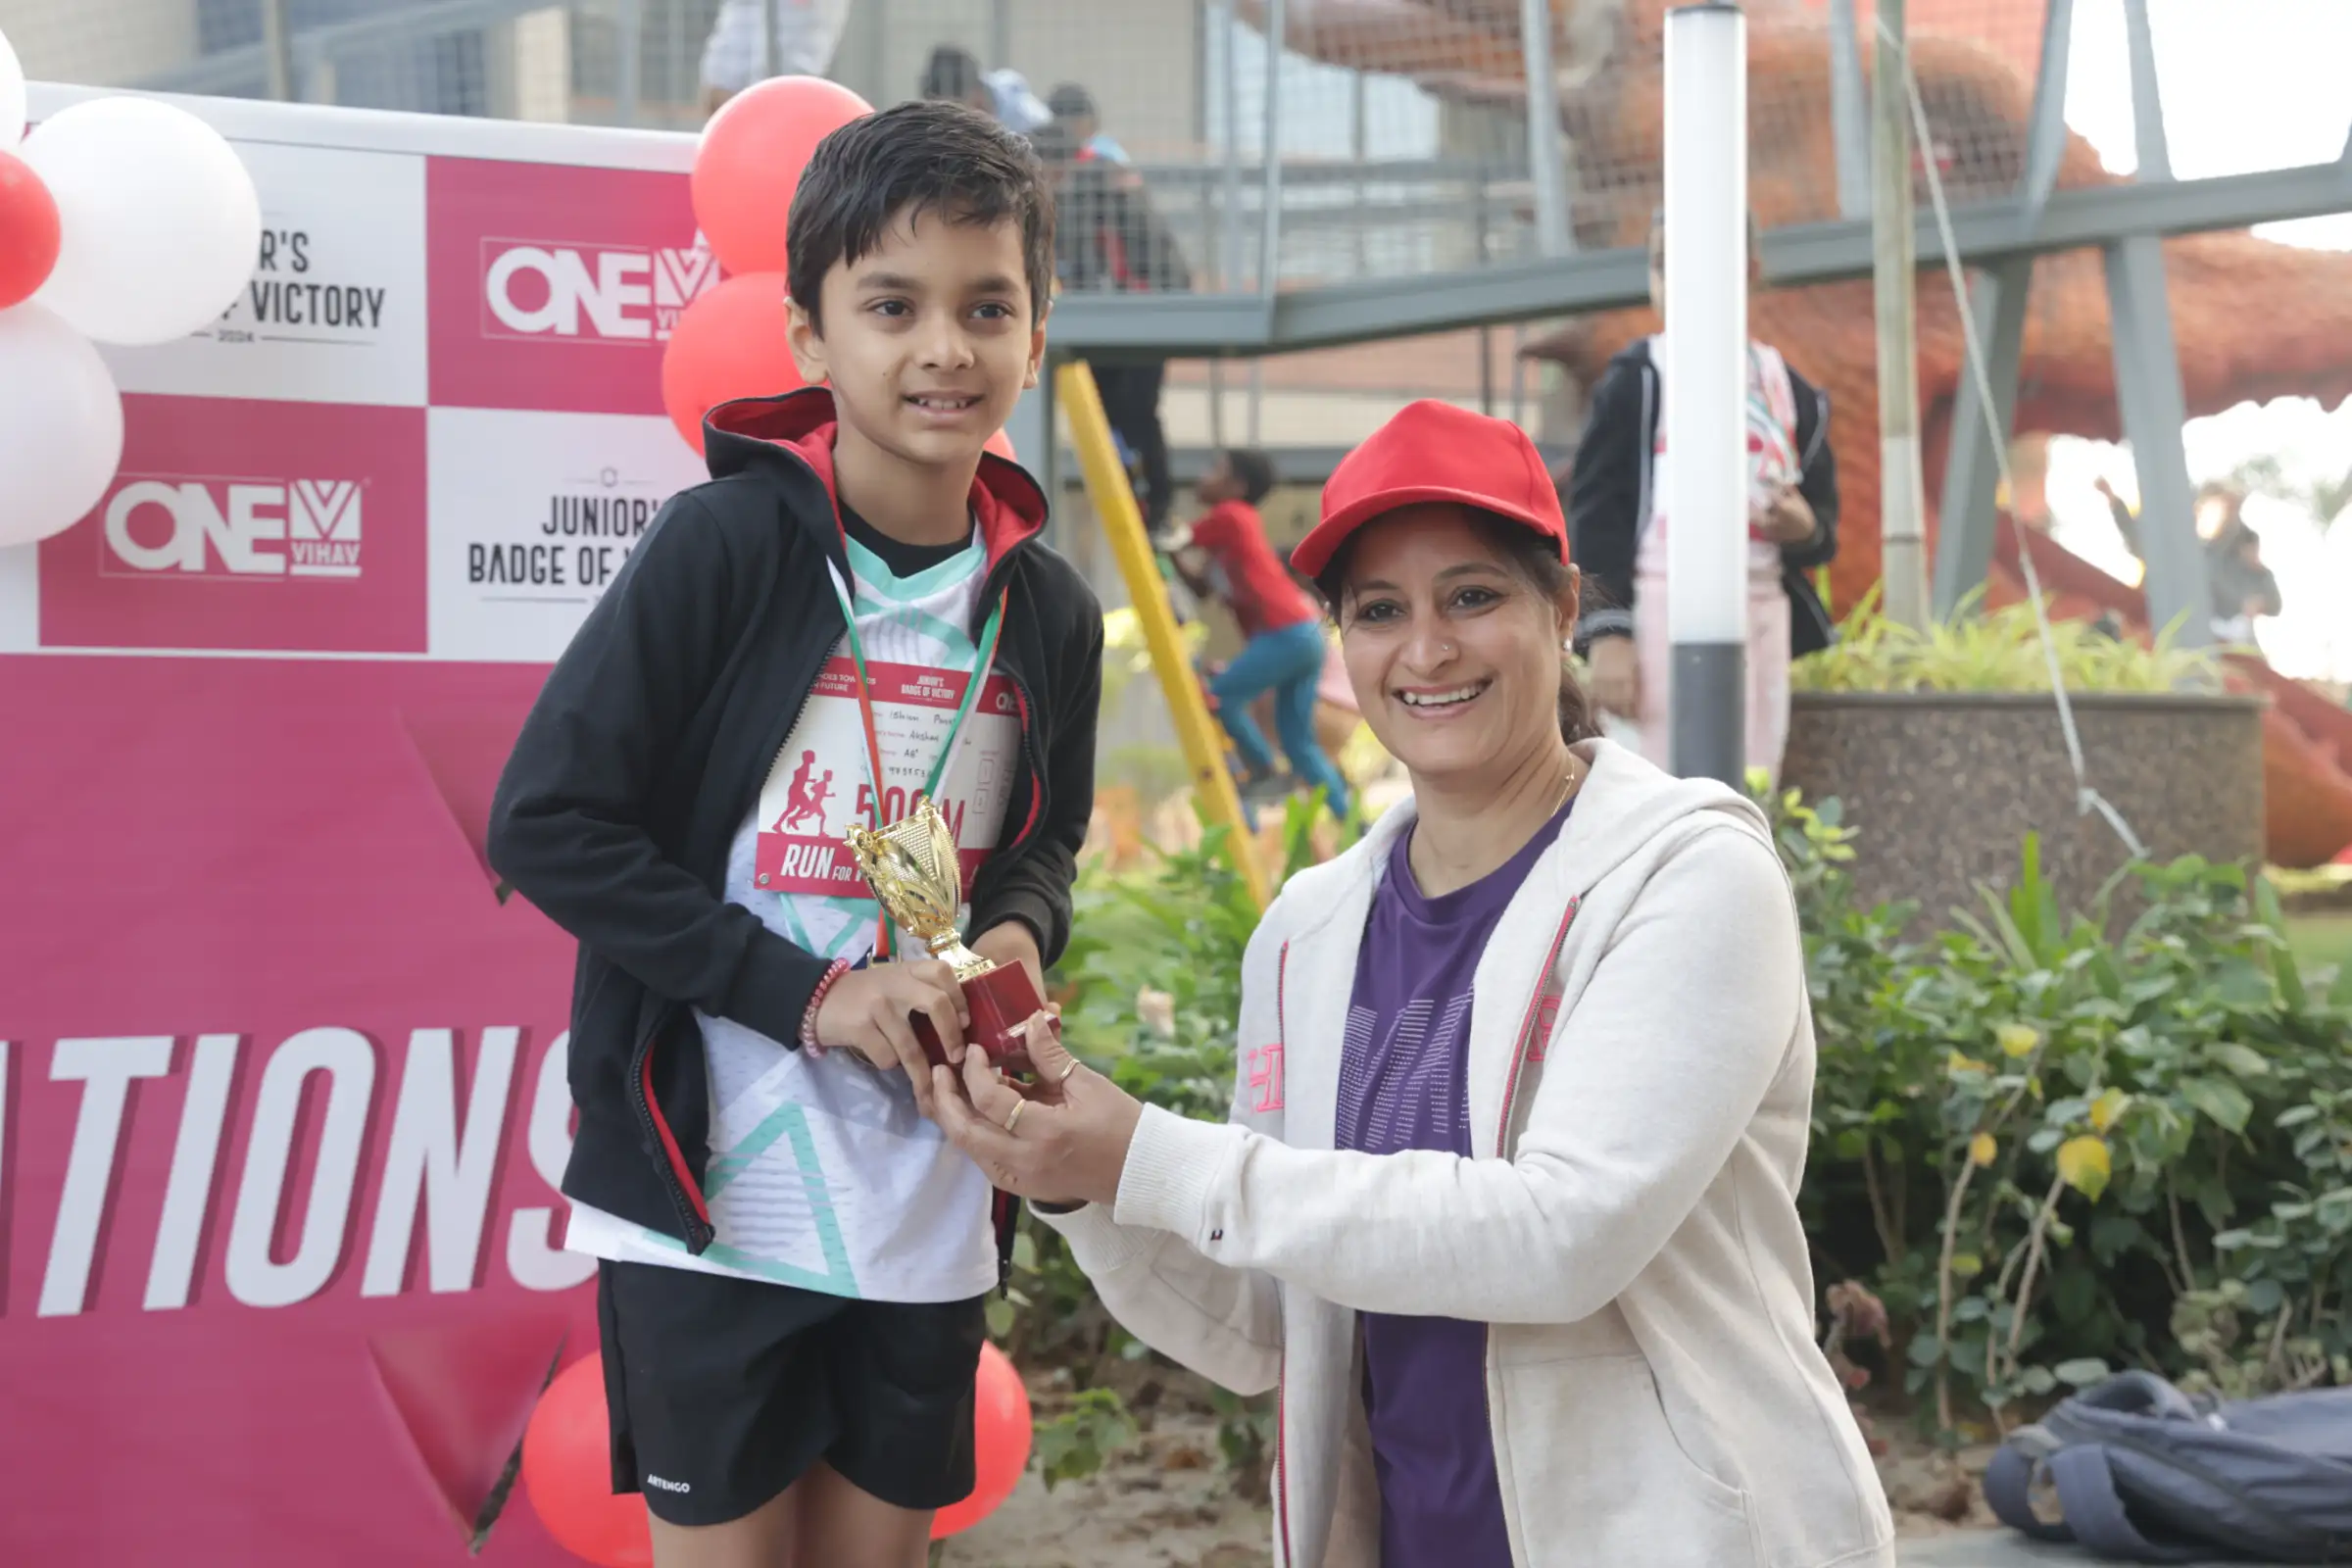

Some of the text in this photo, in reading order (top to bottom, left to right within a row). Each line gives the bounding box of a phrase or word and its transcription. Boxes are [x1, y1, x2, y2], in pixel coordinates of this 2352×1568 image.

[259, 229, 309, 272] R'S
[251, 279, 386, 328] VICTORY
[486, 246, 651, 338] ONE
[105, 480, 286, 574] ONE
[541, 495, 659, 537] JUNIOR'
[291, 542, 361, 564] VIHAV
[468, 543, 613, 586] BADGE OF
[781, 844, 835, 878] RUN
[833, 866, 852, 881] FOR
[647, 1473, 691, 1494] ARTENGO
